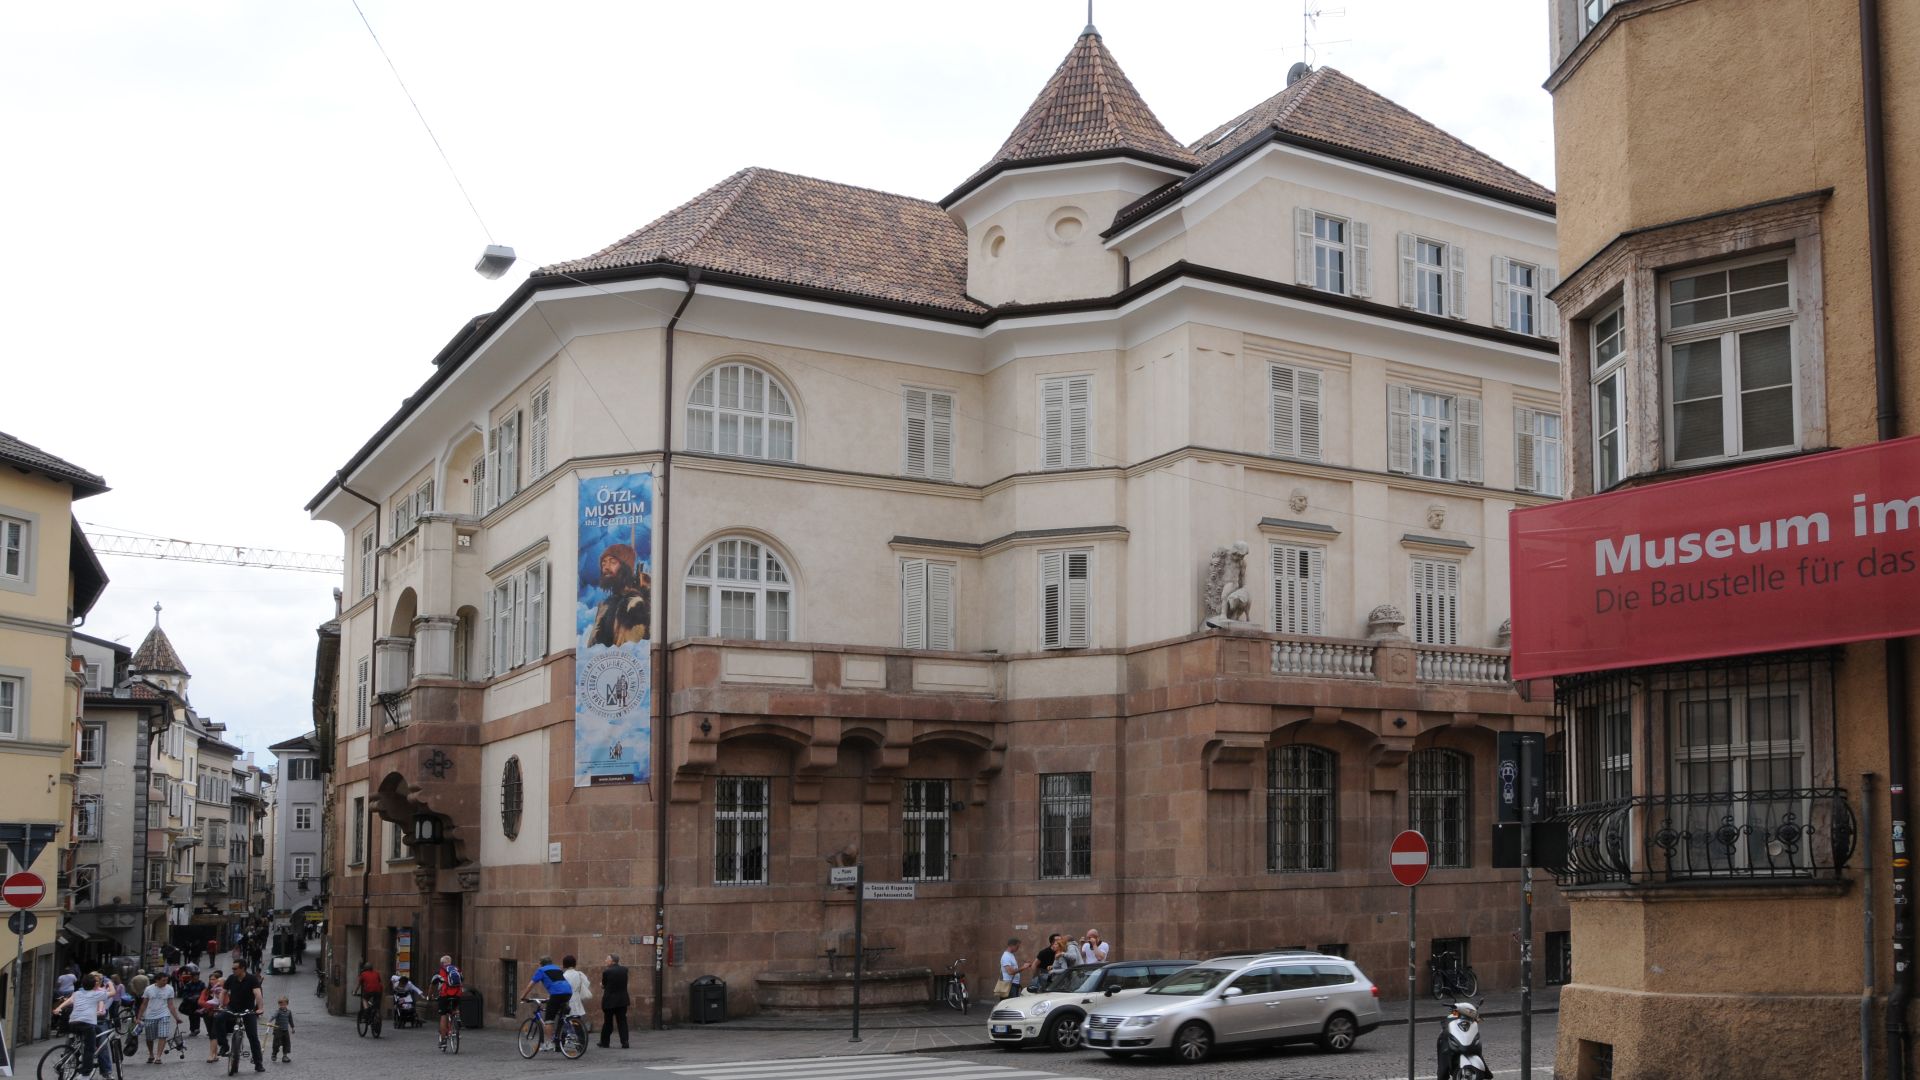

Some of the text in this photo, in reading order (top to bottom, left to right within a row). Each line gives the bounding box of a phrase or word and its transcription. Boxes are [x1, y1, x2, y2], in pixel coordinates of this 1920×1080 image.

[585, 501, 644, 517] MUSEUM
[597, 514, 643, 527] Iceman
[1595, 493, 1920, 577] Museum im
[1596, 547, 1916, 614] Die Baustelle für das
